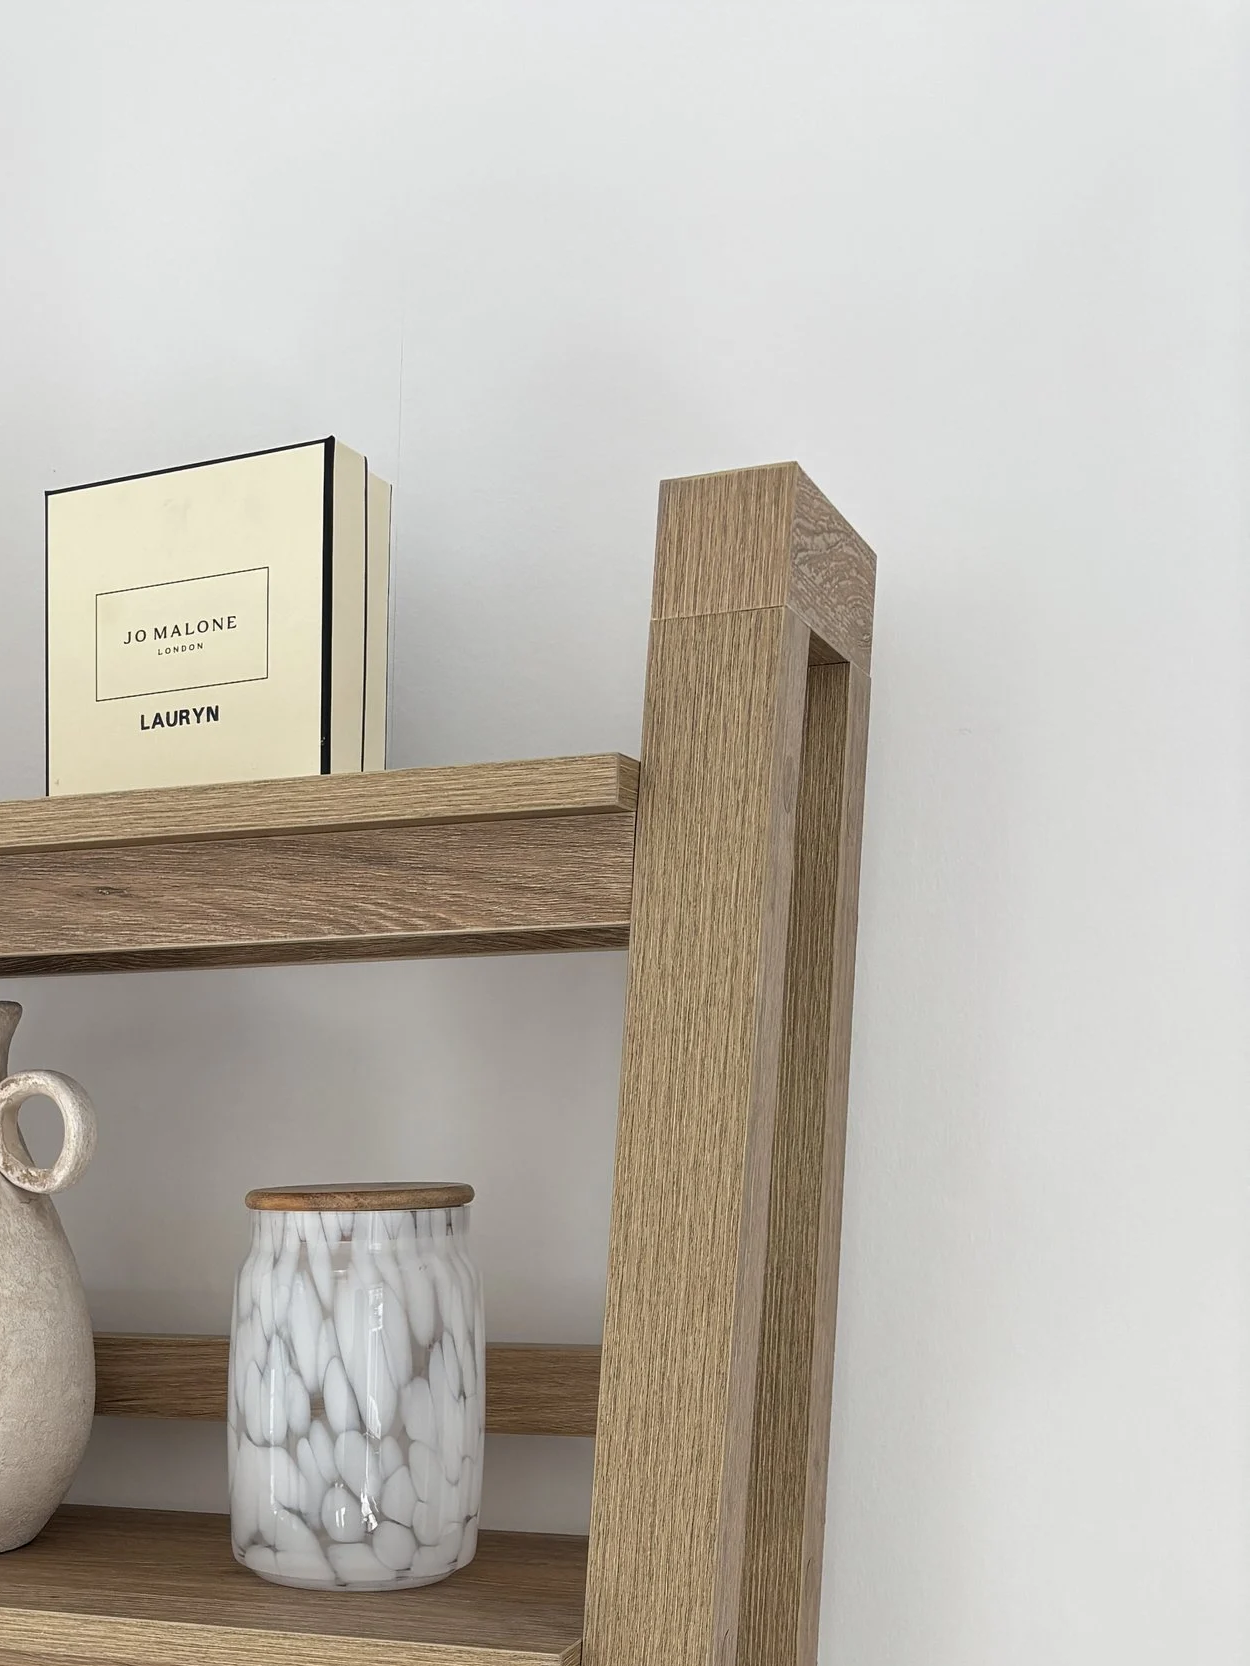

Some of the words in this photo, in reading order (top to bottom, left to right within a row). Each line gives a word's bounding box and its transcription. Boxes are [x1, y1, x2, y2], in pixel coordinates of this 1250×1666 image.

[123, 629, 147, 645] JO
[153, 615, 237, 640] MALONE
[157, 642, 204, 656] LONDON
[140, 705, 220, 731] LAURYN
